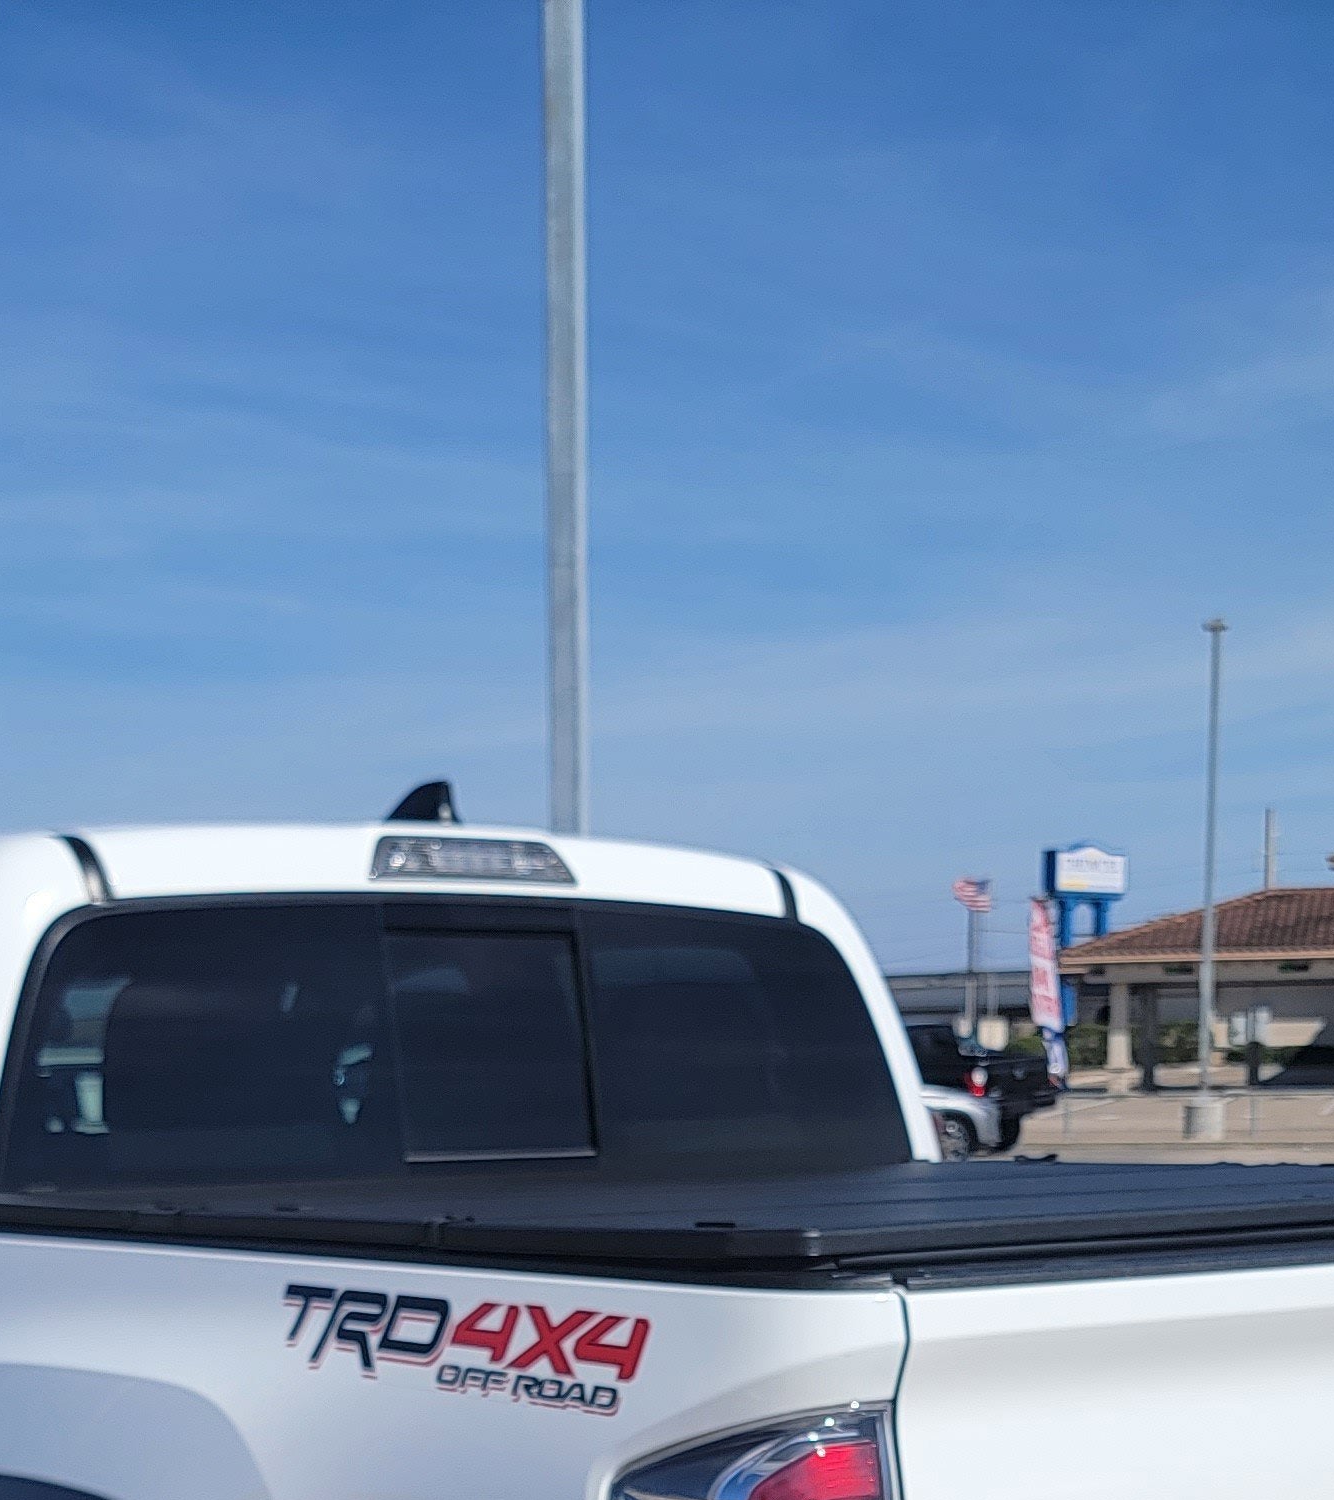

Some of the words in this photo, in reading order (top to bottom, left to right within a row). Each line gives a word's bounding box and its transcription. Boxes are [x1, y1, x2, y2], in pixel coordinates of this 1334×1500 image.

[285, 1284, 451, 1374] TRD
[452, 1302, 651, 1381] 4X4
[436, 1364, 509, 1394] OFF
[512, 1374, 620, 1411] ROAD
